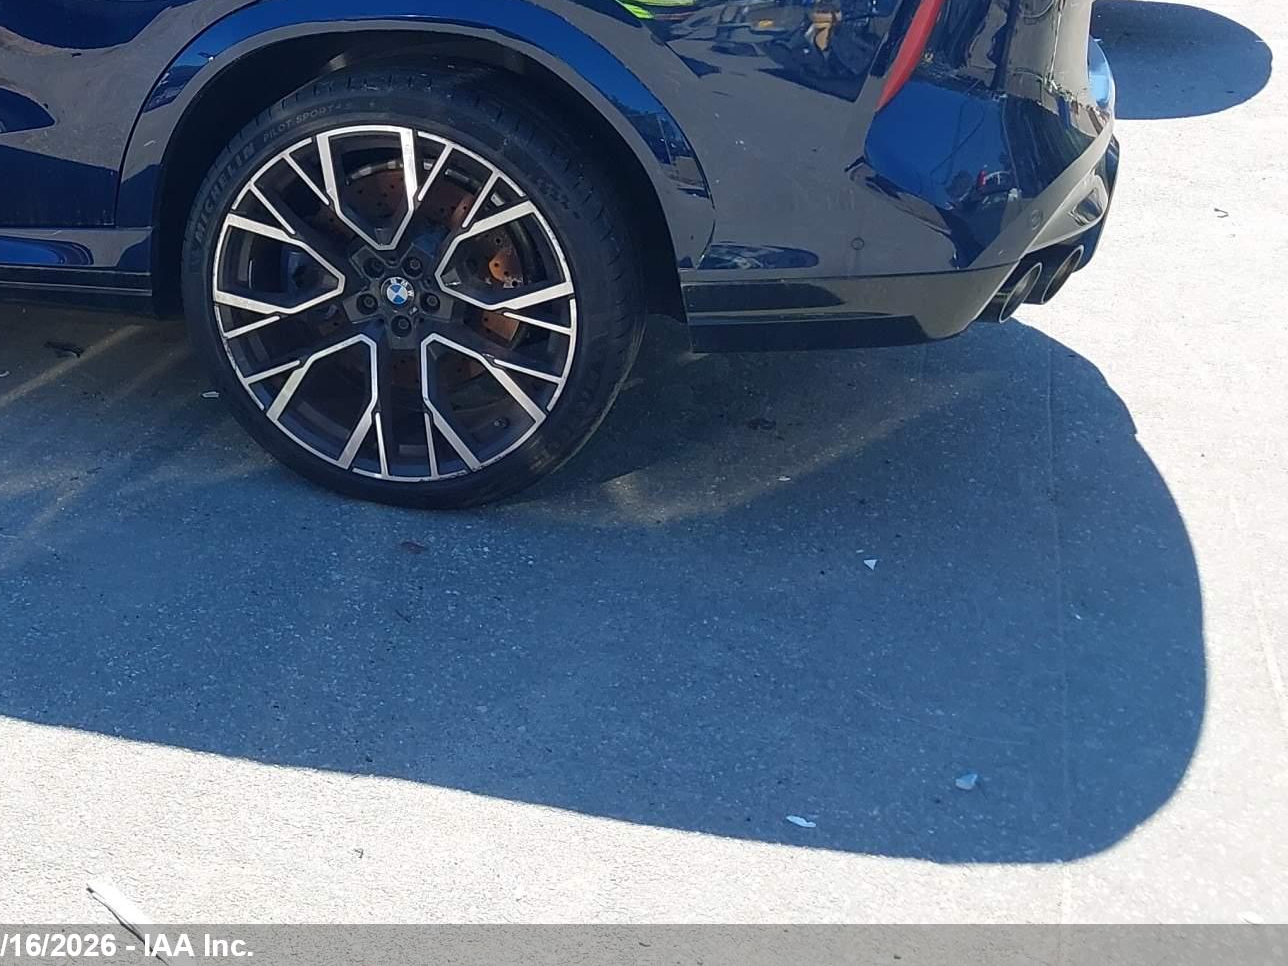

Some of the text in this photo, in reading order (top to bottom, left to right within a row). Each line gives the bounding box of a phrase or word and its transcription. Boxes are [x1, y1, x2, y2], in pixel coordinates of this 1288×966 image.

[262, 119, 293, 143] PILOT
[295, 104, 336, 125] SPORT
[193, 141, 257, 246] MICHELIN
